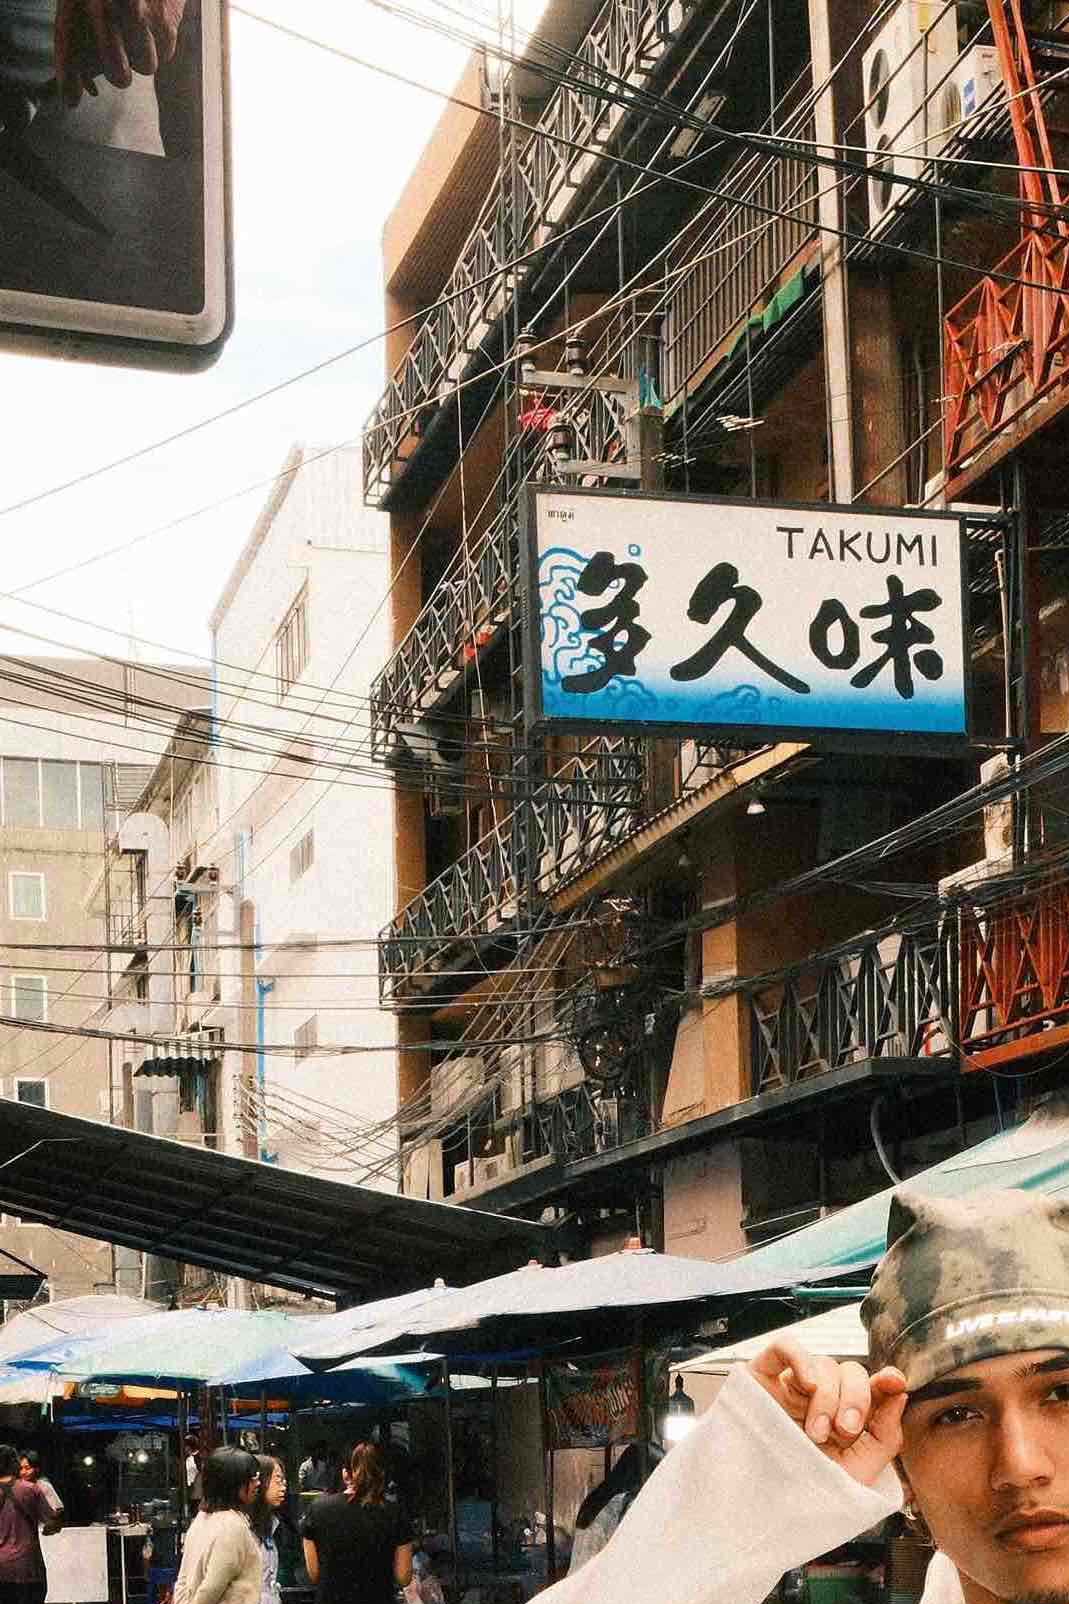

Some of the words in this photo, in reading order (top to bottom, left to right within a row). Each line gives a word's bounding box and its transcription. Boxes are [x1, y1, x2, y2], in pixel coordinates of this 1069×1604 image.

[777, 527, 938, 566] TAKUMI
[561, 551, 944, 699] 多久味
